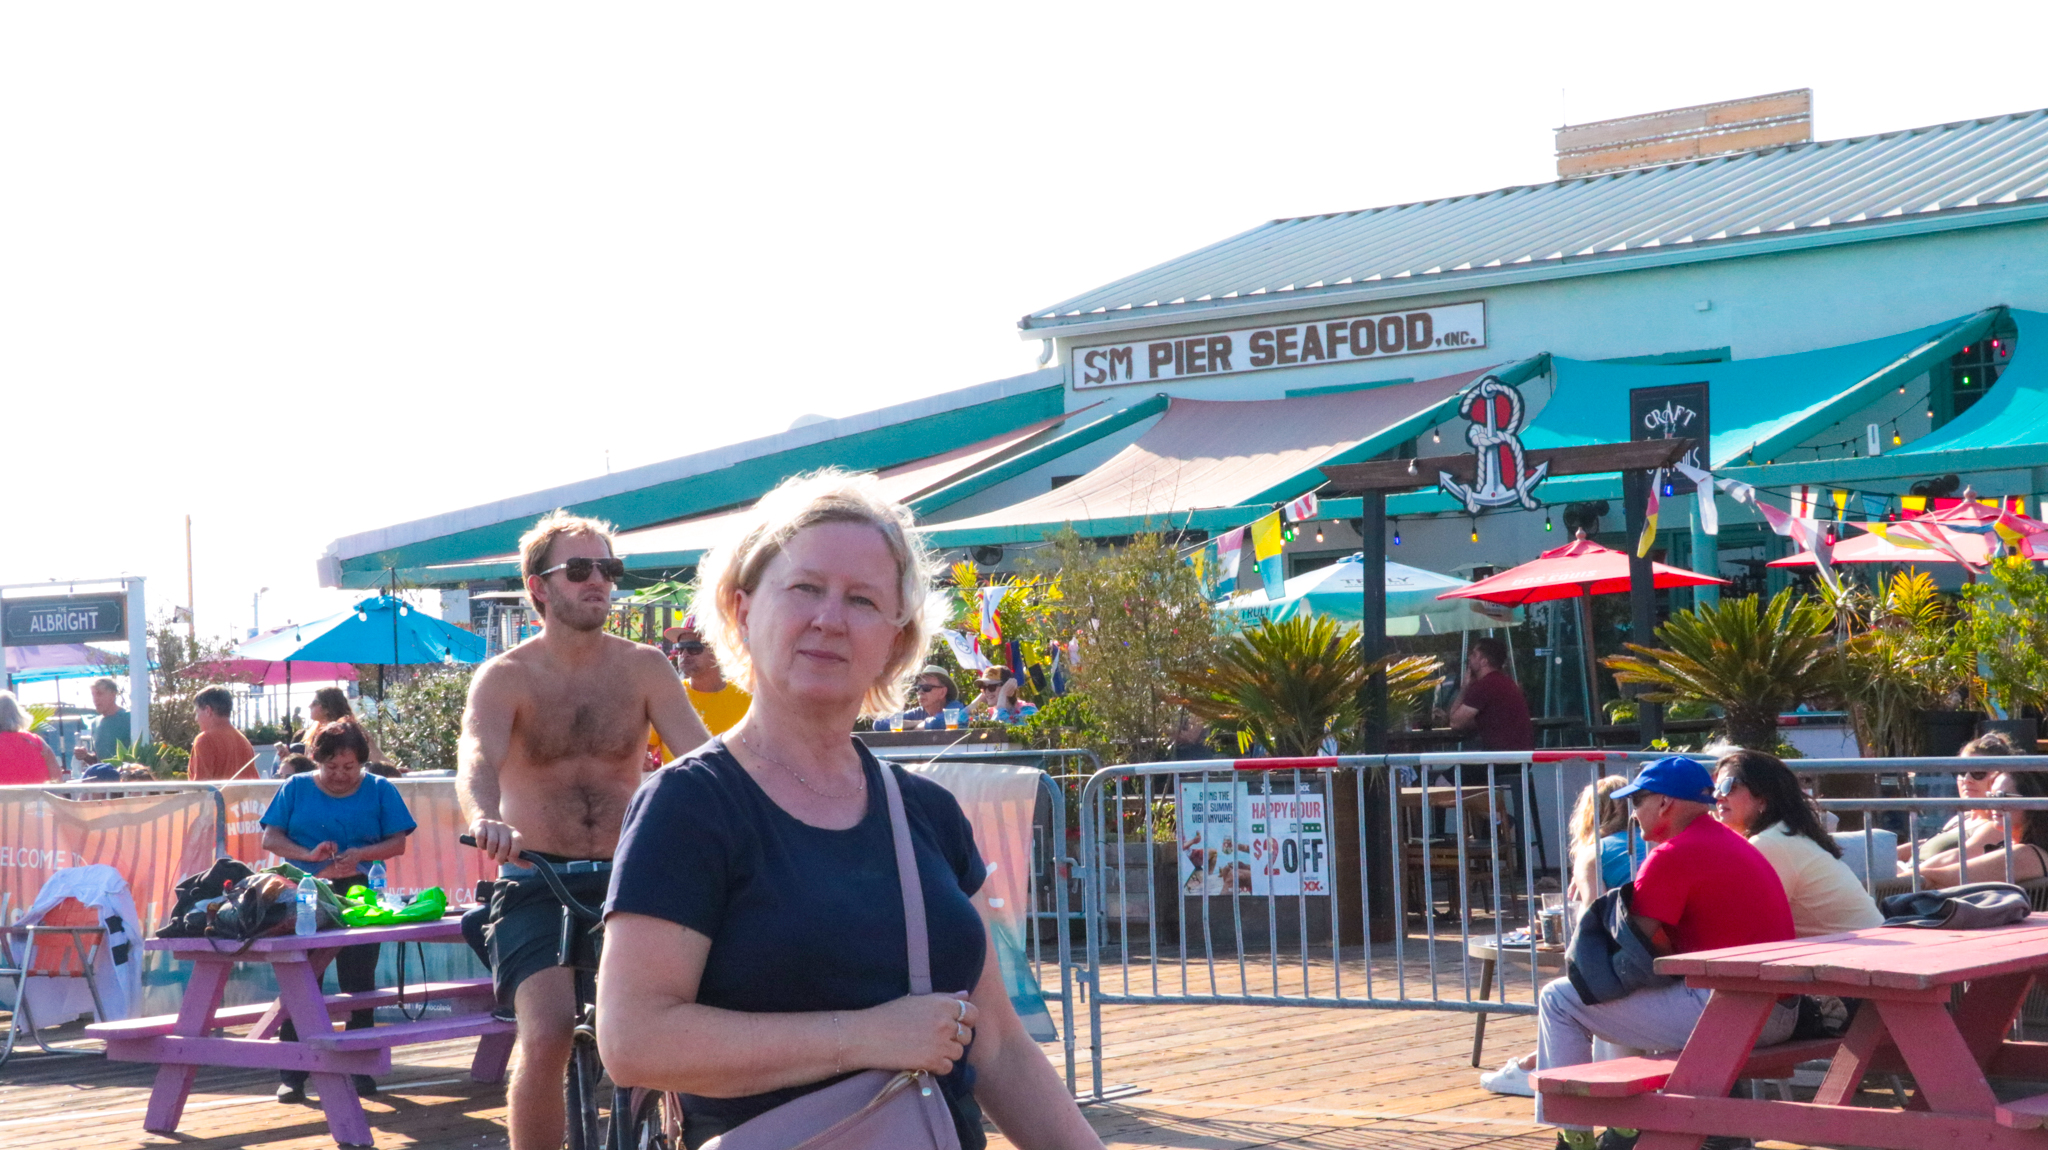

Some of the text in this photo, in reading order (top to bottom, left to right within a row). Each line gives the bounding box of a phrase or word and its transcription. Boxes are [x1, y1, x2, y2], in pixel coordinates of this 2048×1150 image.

[1084, 346, 1133, 385] SM
[1148, 335, 1233, 378] PIER
[1644, 400, 1697, 429] CRAFT
[1241, 604, 1271, 619] TRULY
[30, 612, 98, 633] ALBRIGHT
[1218, 791, 1230, 801] THE
[230, 800, 266, 818] THIRD
[1210, 802, 1233, 812] SUMME
[0, 846, 66, 871] ELCOME
[1253, 837, 1324, 876] $2 OFF
